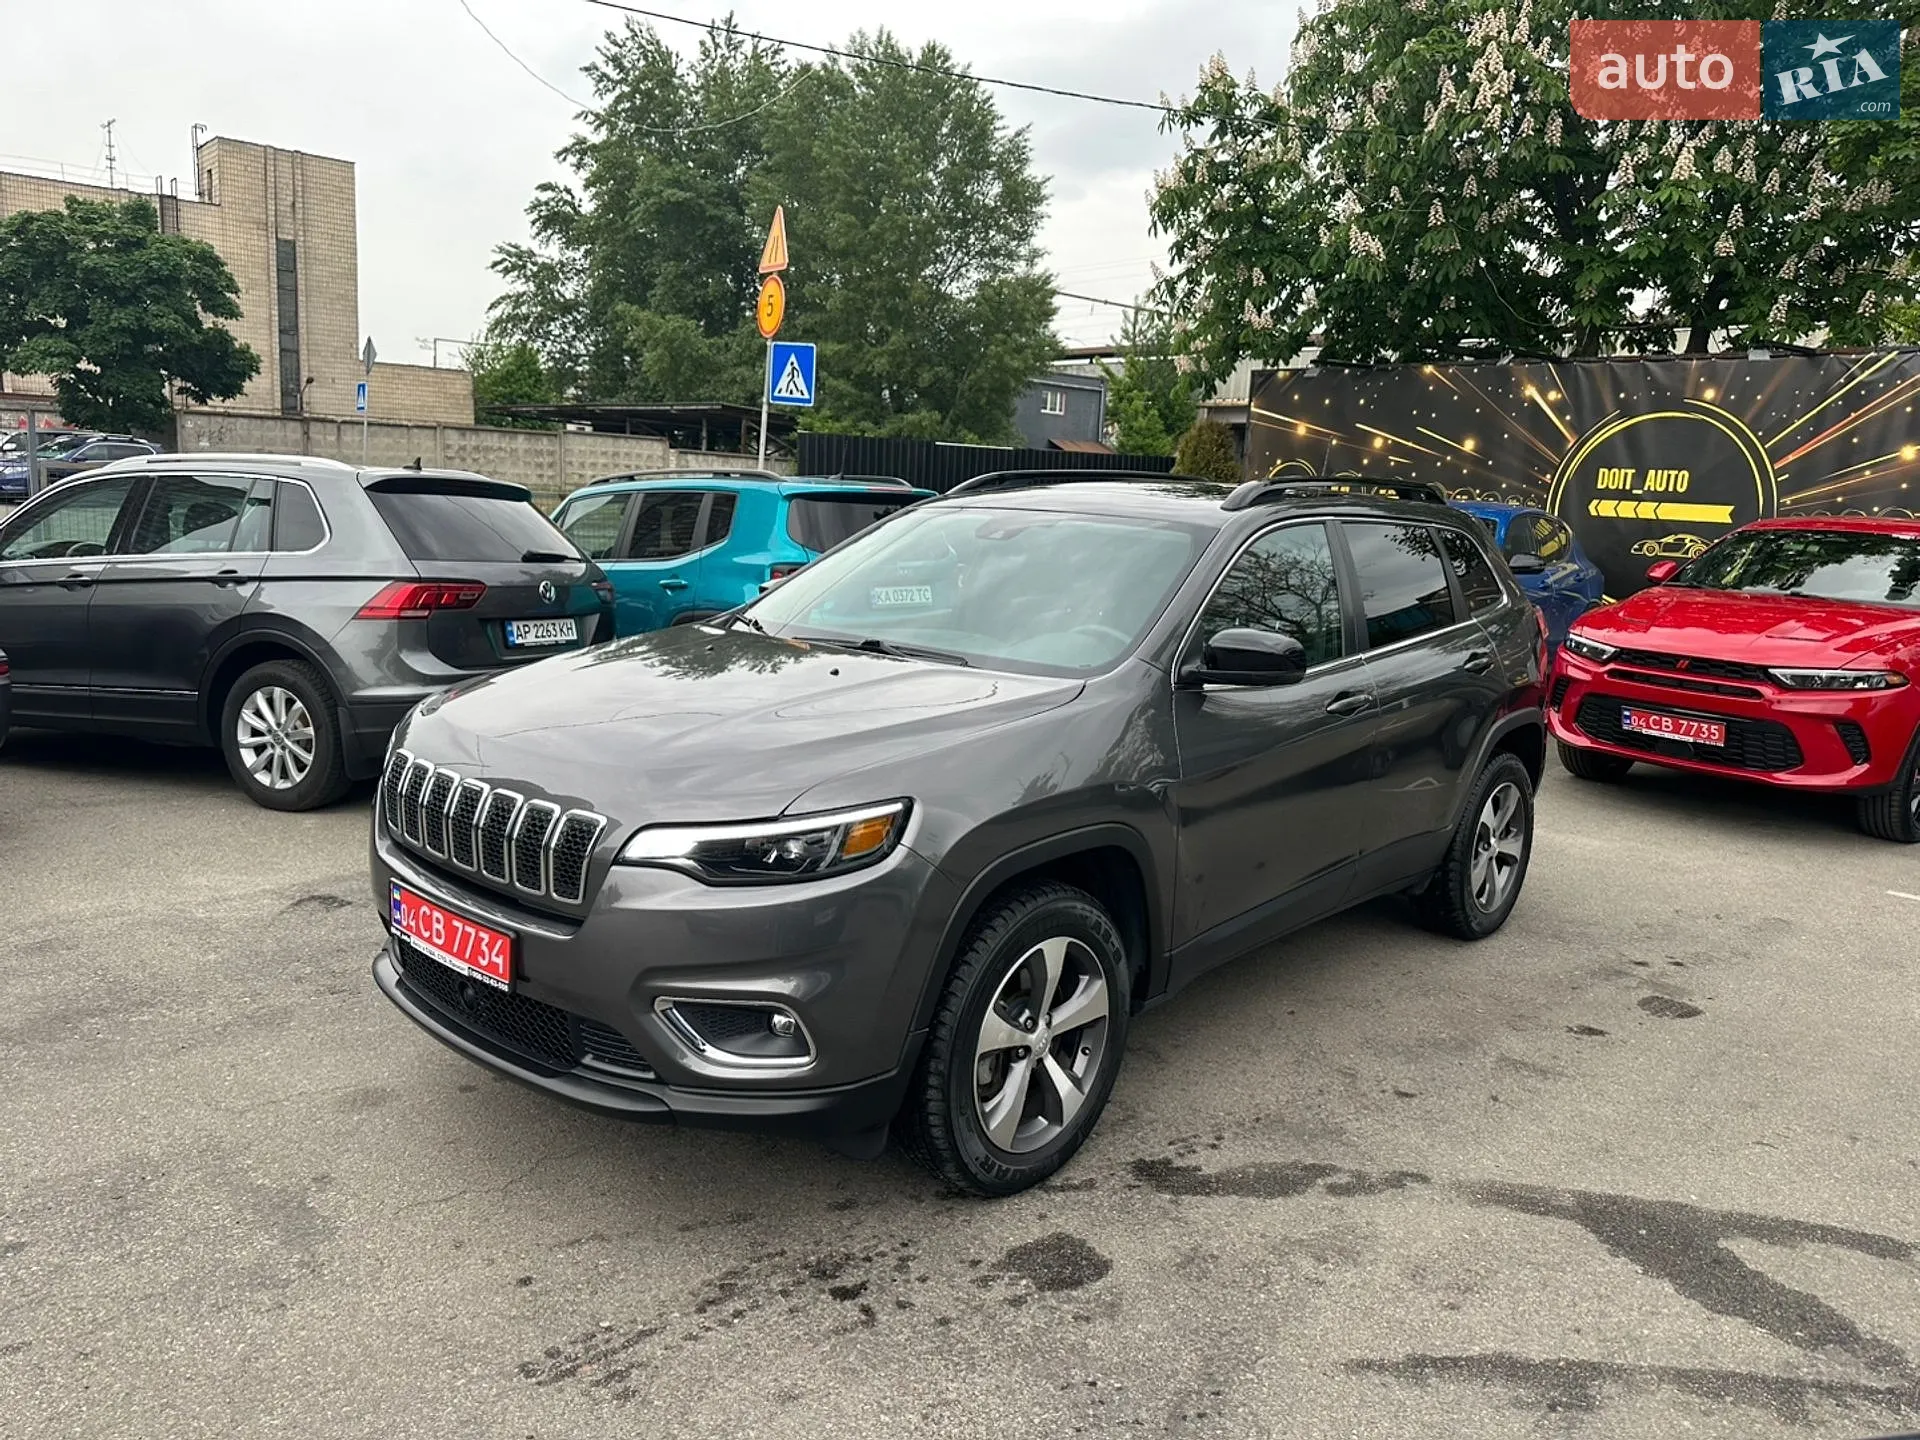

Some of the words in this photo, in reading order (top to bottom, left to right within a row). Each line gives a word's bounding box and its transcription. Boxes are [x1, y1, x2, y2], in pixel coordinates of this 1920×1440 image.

[766, 294, 775, 317] 5
[1597, 467, 1690, 494] DOIT_AUTO
[516, 624, 531, 640] AP
[533, 622, 558, 639] 2263
[559, 621, 574, 637] KH
[1678, 719, 1720, 740] 7735
[450, 919, 505, 975] 7734
